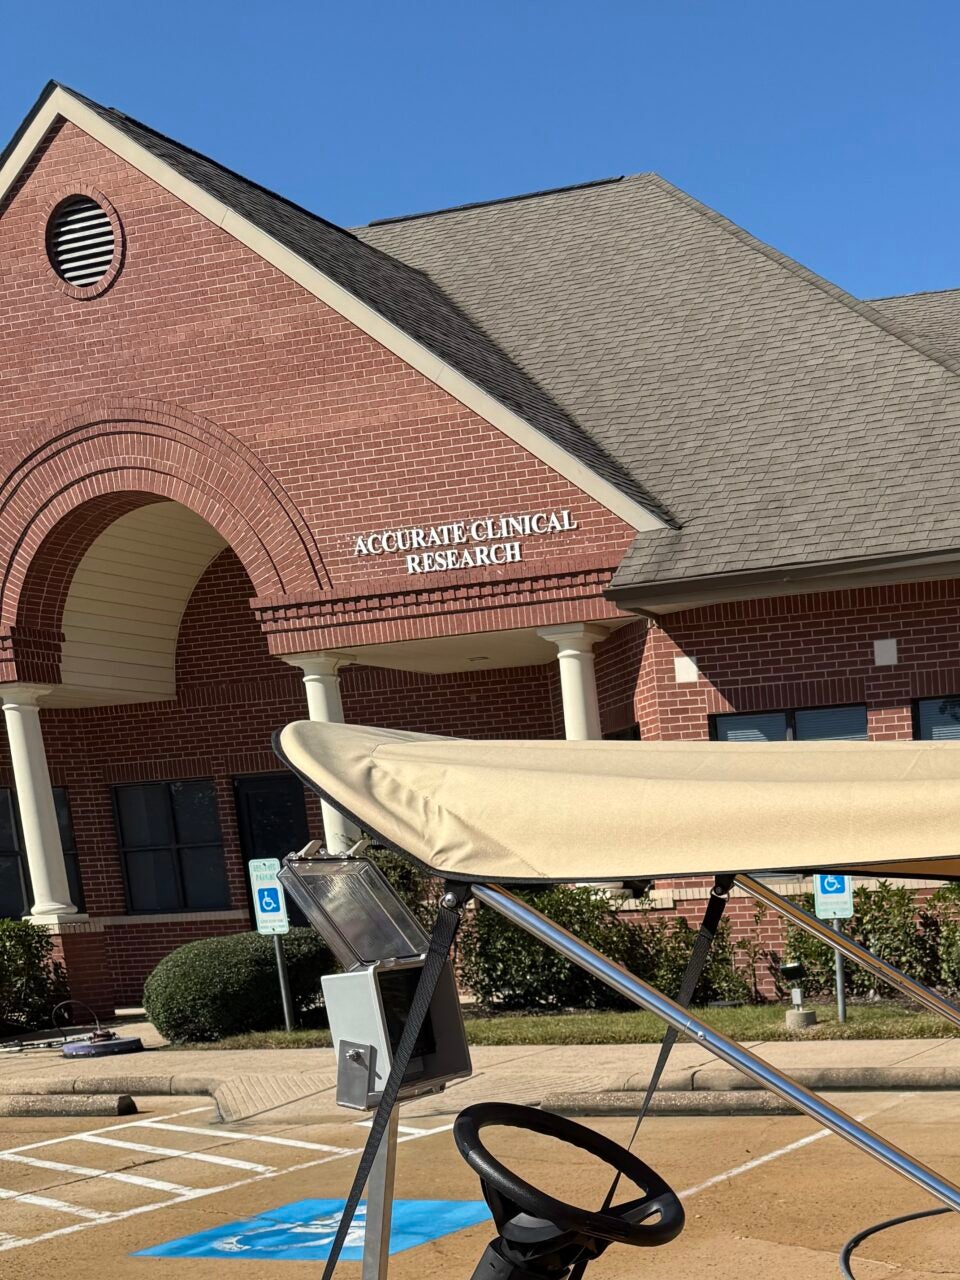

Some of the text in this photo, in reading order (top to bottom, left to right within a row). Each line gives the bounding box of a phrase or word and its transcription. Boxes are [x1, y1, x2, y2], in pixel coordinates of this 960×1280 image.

[353, 509, 578, 556] ACCURATE CLINICAL
[406, 541, 523, 575] RESEARCH
